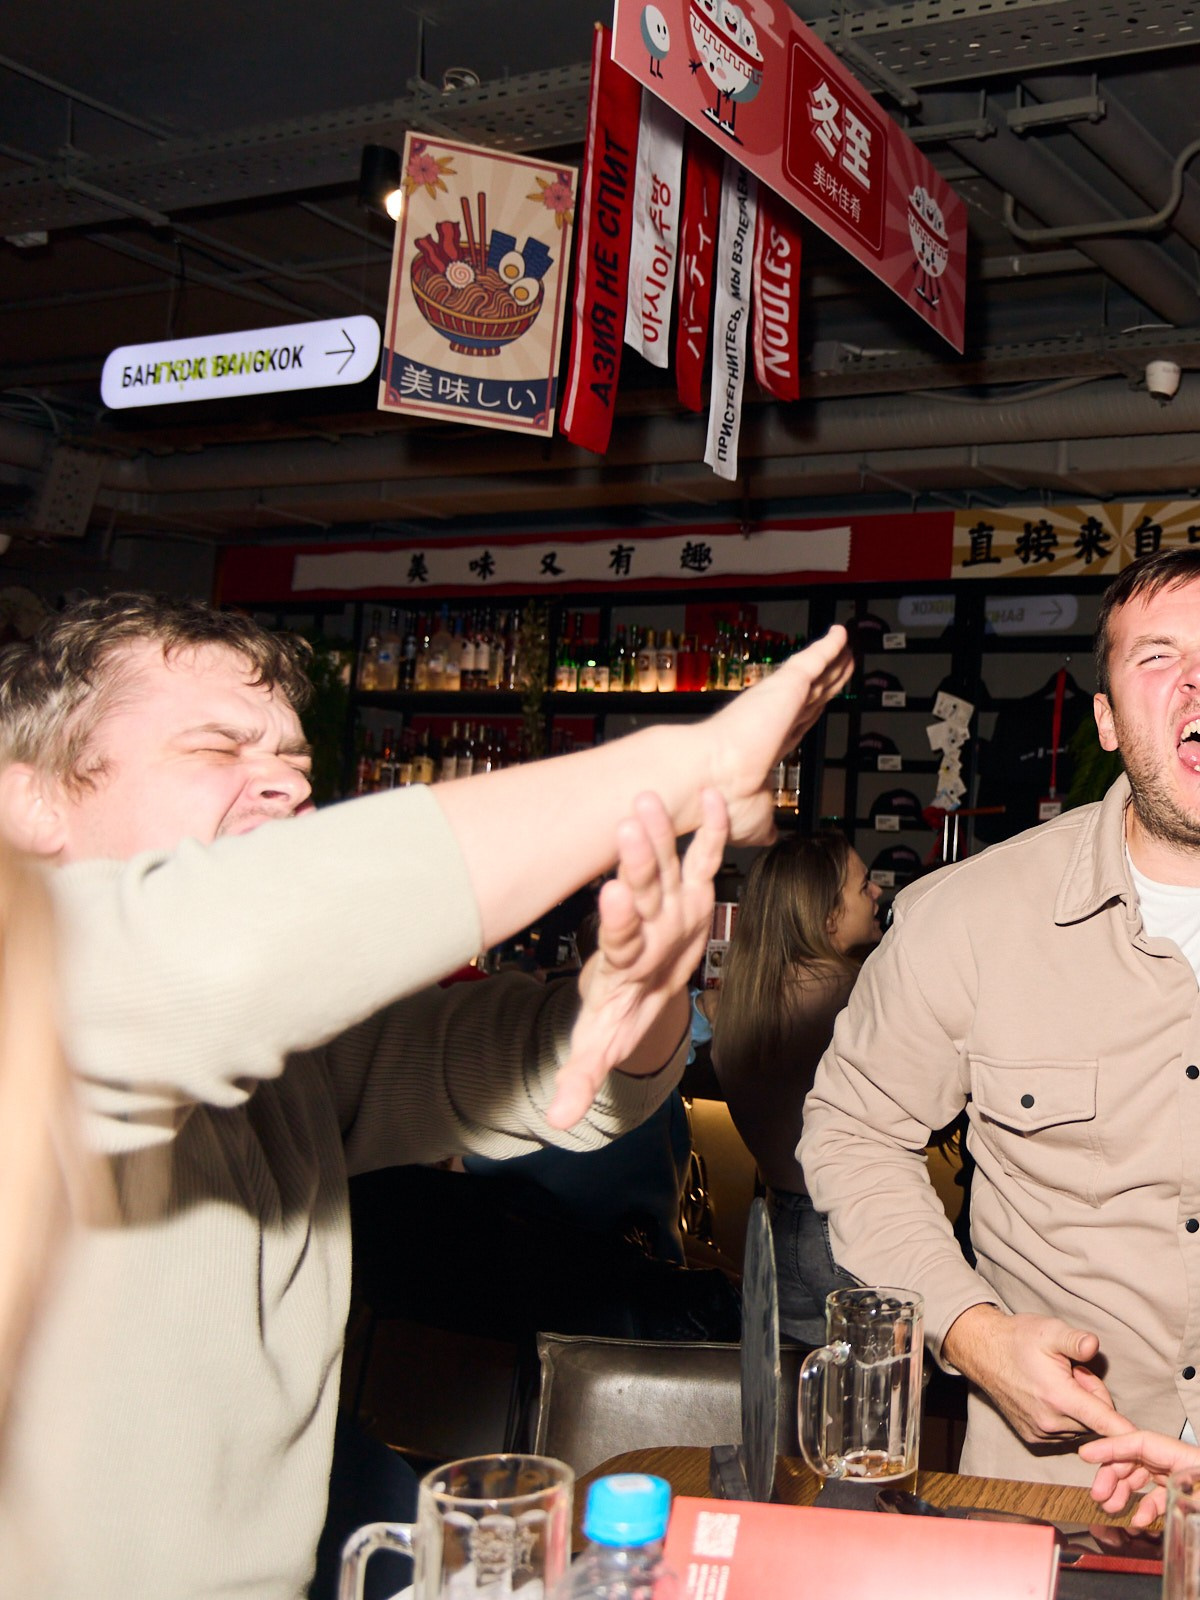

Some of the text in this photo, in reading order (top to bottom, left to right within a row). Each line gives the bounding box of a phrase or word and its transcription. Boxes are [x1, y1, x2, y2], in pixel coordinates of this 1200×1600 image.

[813, 161, 861, 223] 美味佳肴
[590, 129, 629, 407] АЗИЯ НЕ СПИТ
[642, 244, 672, 342] 아시아
[682, 187, 712, 360] パーティー
[718, 167, 750, 462] ПРИСТЕГНИТЕСЬ, МЫ ВЗЛЕТАЕМ
[213, 344, 304, 378] BANGKOK
[400, 364, 536, 411] 美味しい
[406, 541, 713, 583] 美味又有趣
